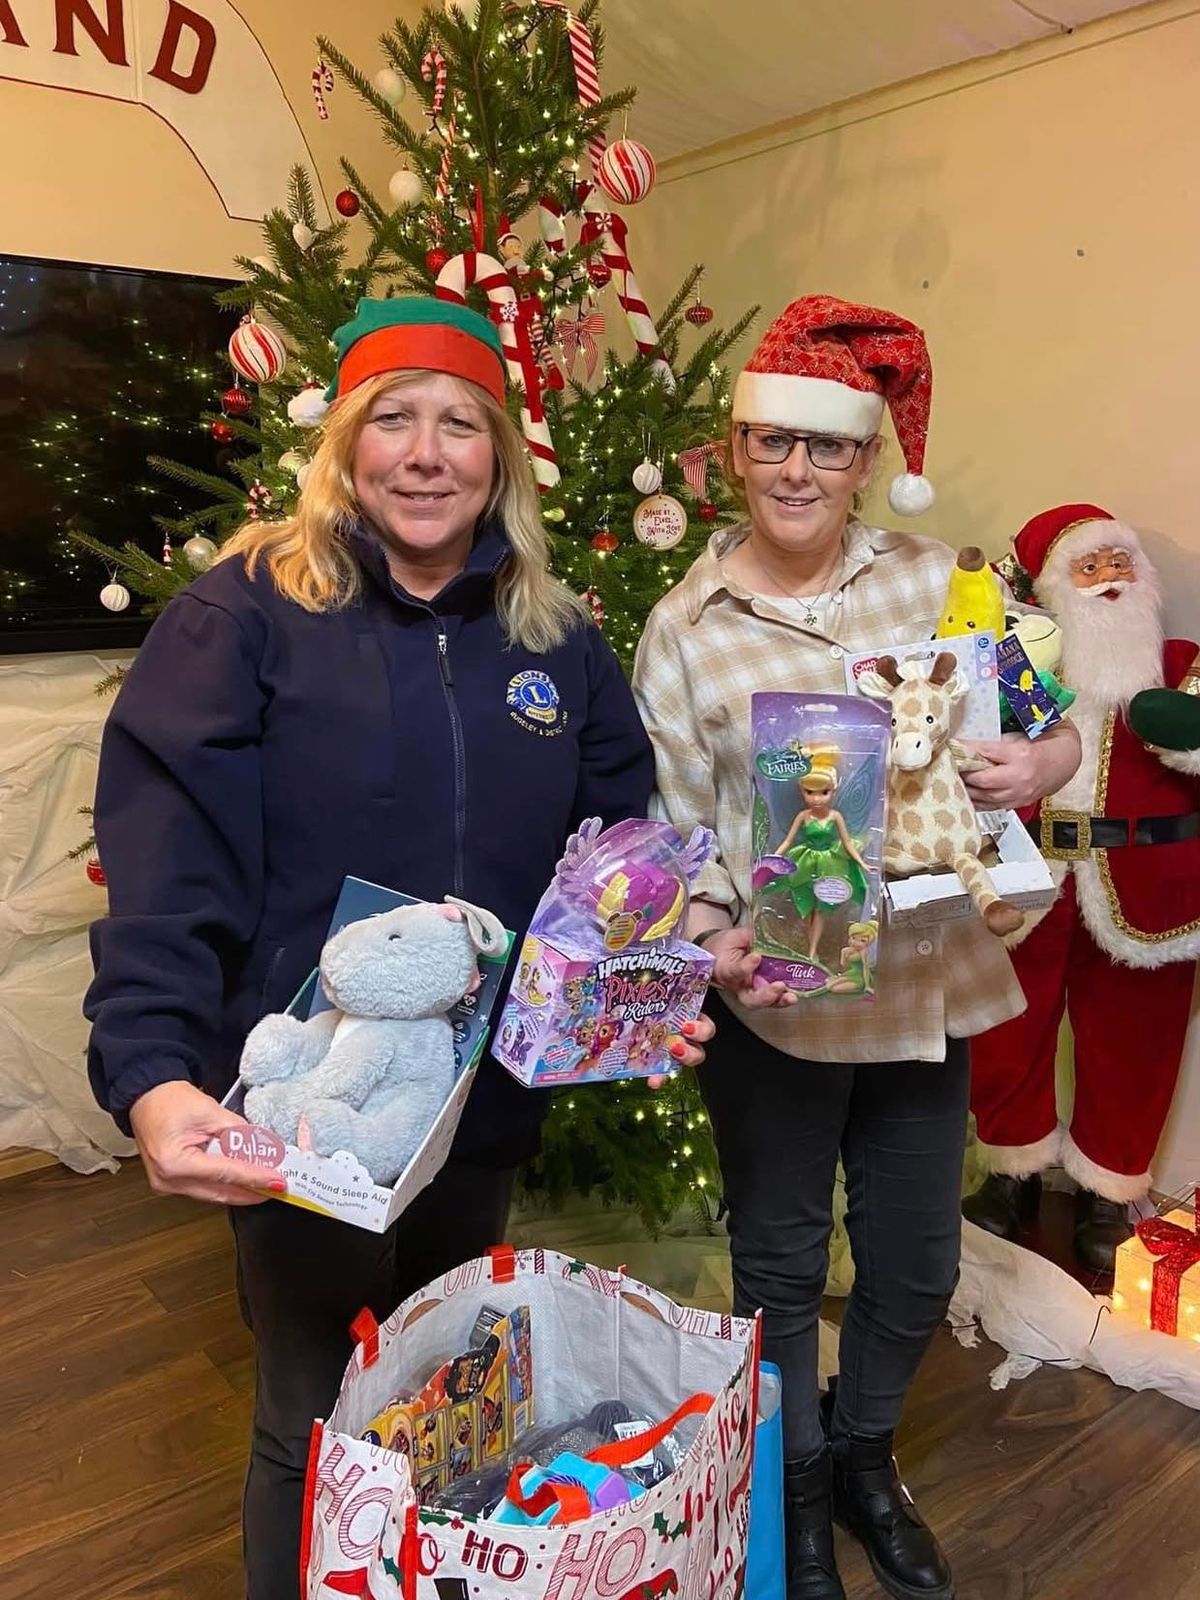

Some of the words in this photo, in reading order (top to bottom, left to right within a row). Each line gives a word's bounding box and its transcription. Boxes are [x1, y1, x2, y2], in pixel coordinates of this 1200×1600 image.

[510, 670, 550, 688] LIONS
[528, 685, 548, 704] L
[766, 759, 807, 776] FAIRIES
[785, 963, 816, 979] Tink
[623, 1002, 668, 1021] Riders
[229, 1130, 277, 1164] Dylan
[279, 1168, 298, 1179] ight
[301, 1173, 308, 1181] &
[310, 1176, 340, 1195] Sound
[342, 1188, 369, 1200] Sleep
[371, 1192, 388, 1206] Aid
[461, 1529, 529, 1582] HO
[542, 1526, 647, 1600] HO
